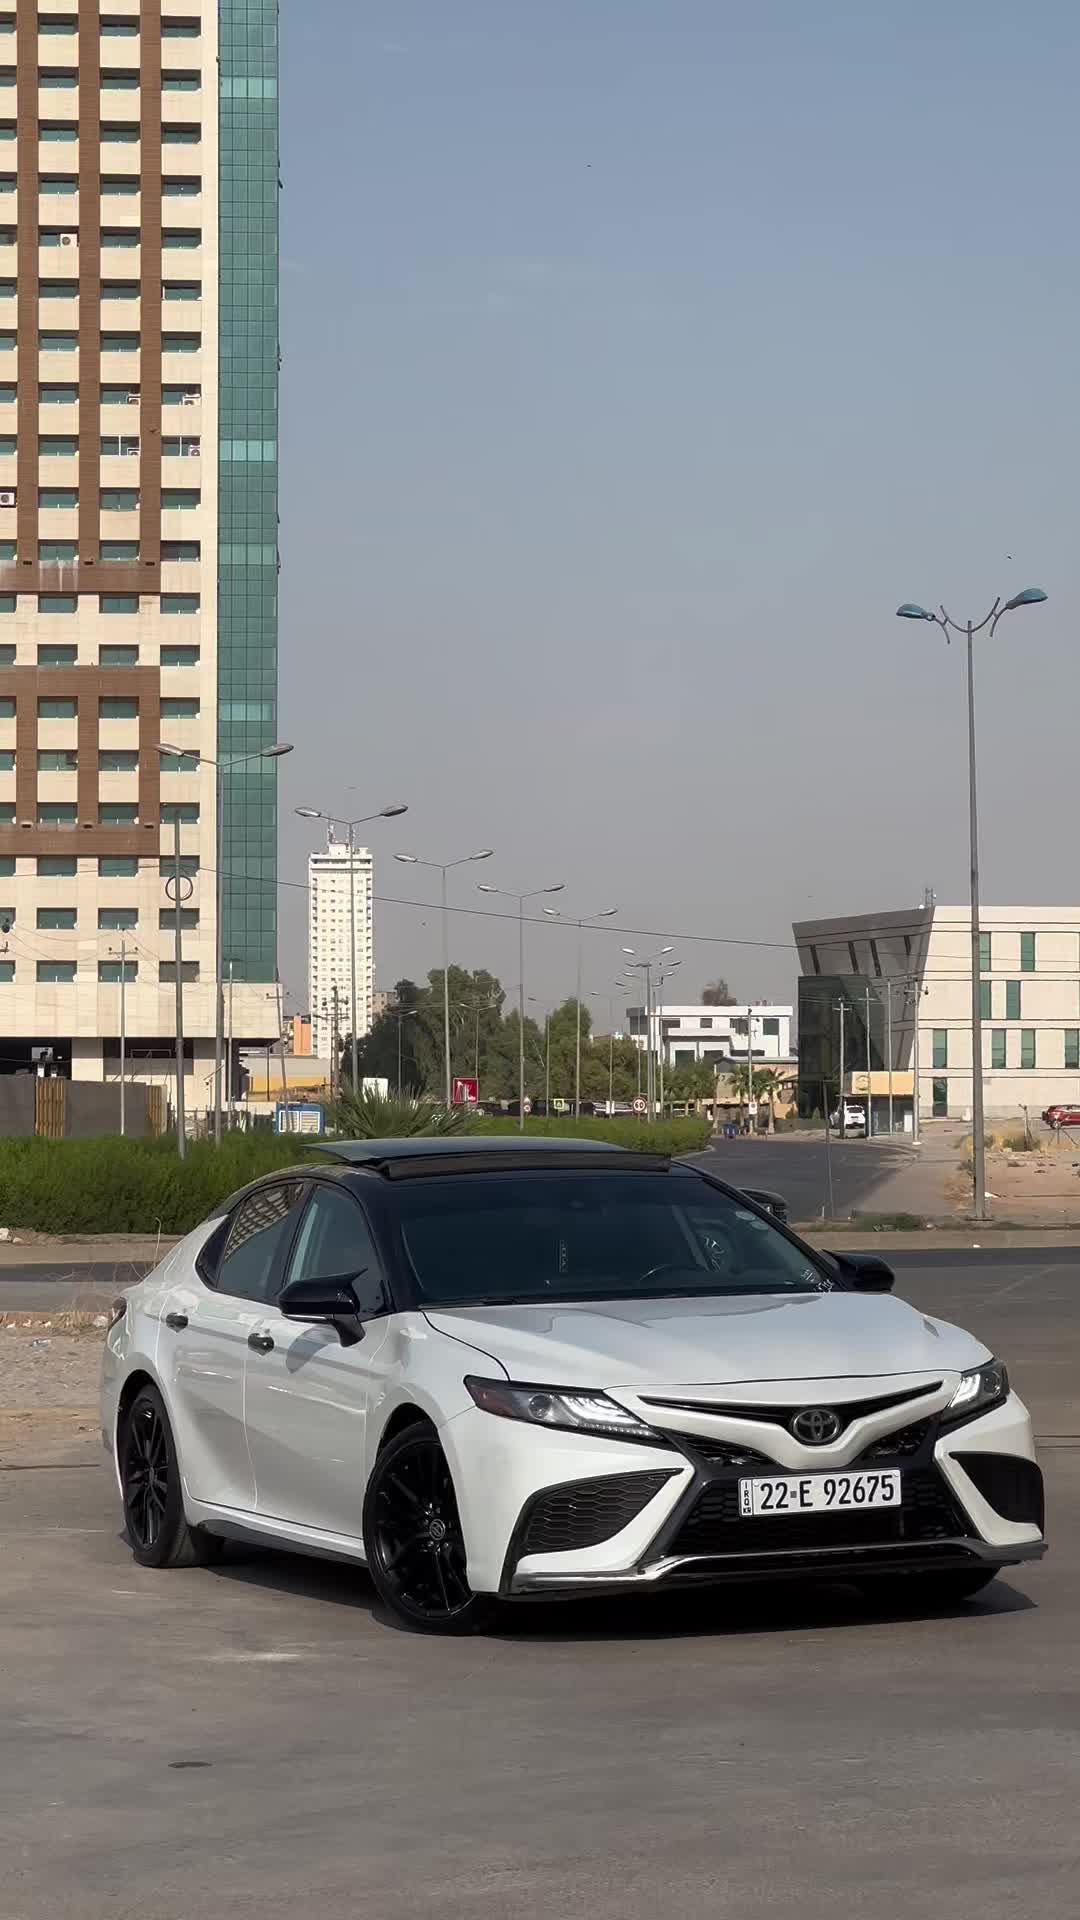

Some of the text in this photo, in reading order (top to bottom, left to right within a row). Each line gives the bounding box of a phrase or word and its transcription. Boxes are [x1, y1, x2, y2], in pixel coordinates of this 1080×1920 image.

[760, 1474, 895, 1510] 22 E 92675
